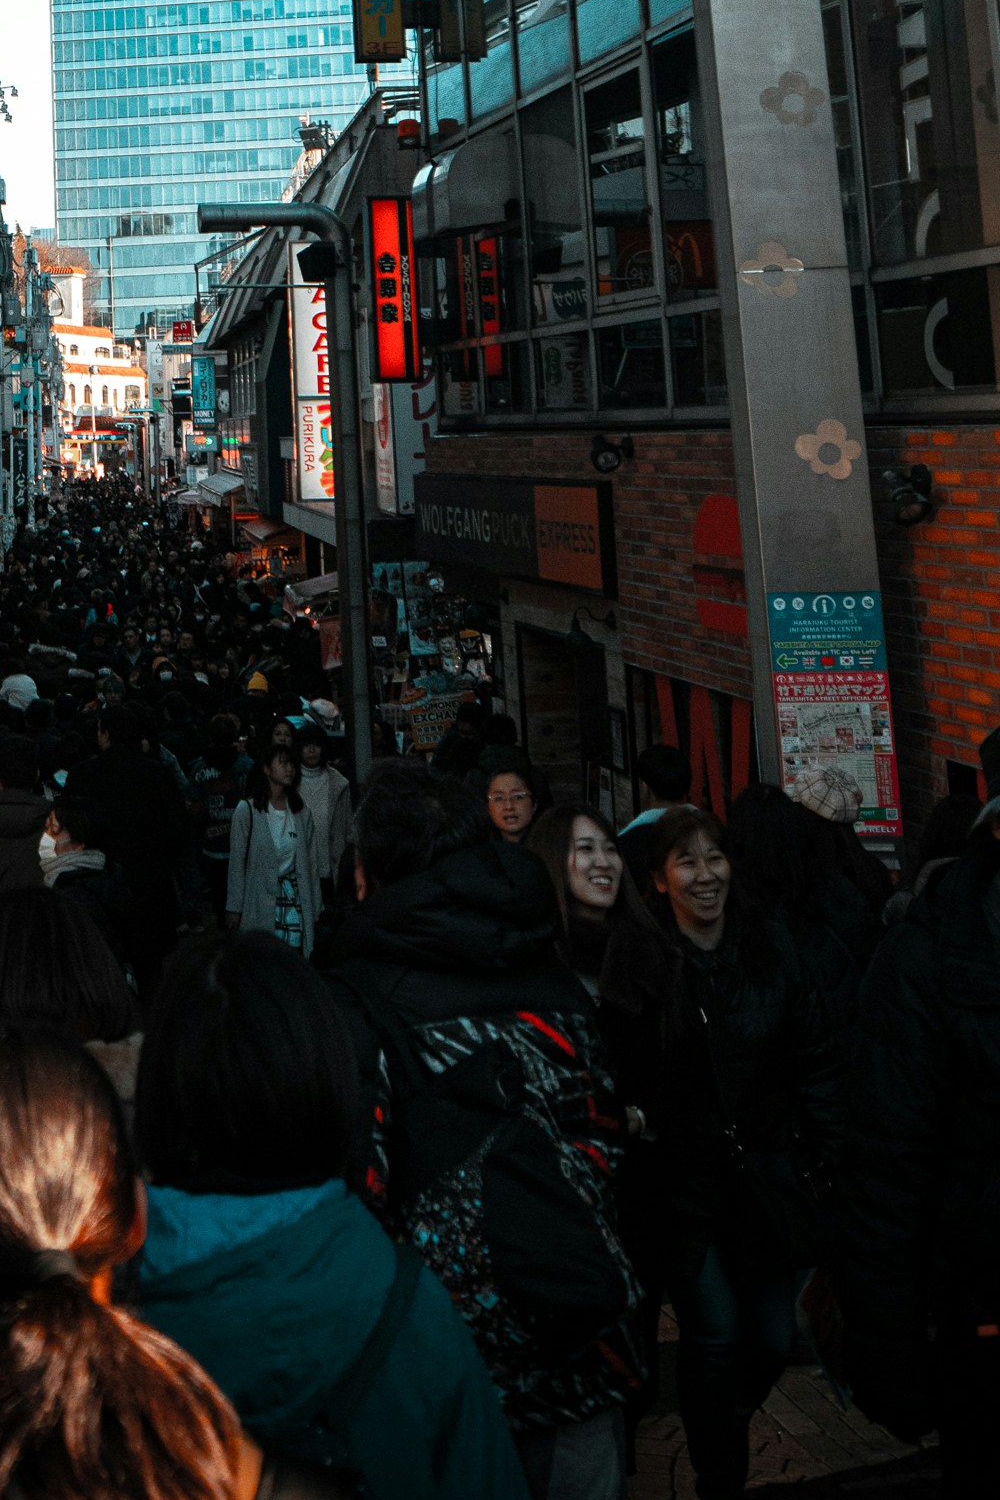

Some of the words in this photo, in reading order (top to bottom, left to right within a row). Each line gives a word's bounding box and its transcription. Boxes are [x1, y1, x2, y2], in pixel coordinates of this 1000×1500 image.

[193, 409, 215, 418] MONEY
[302, 406, 316, 472] PURIKURA
[419, 503, 491, 544] WOLFGANG
[413, 711, 460, 724] EXCHAN
